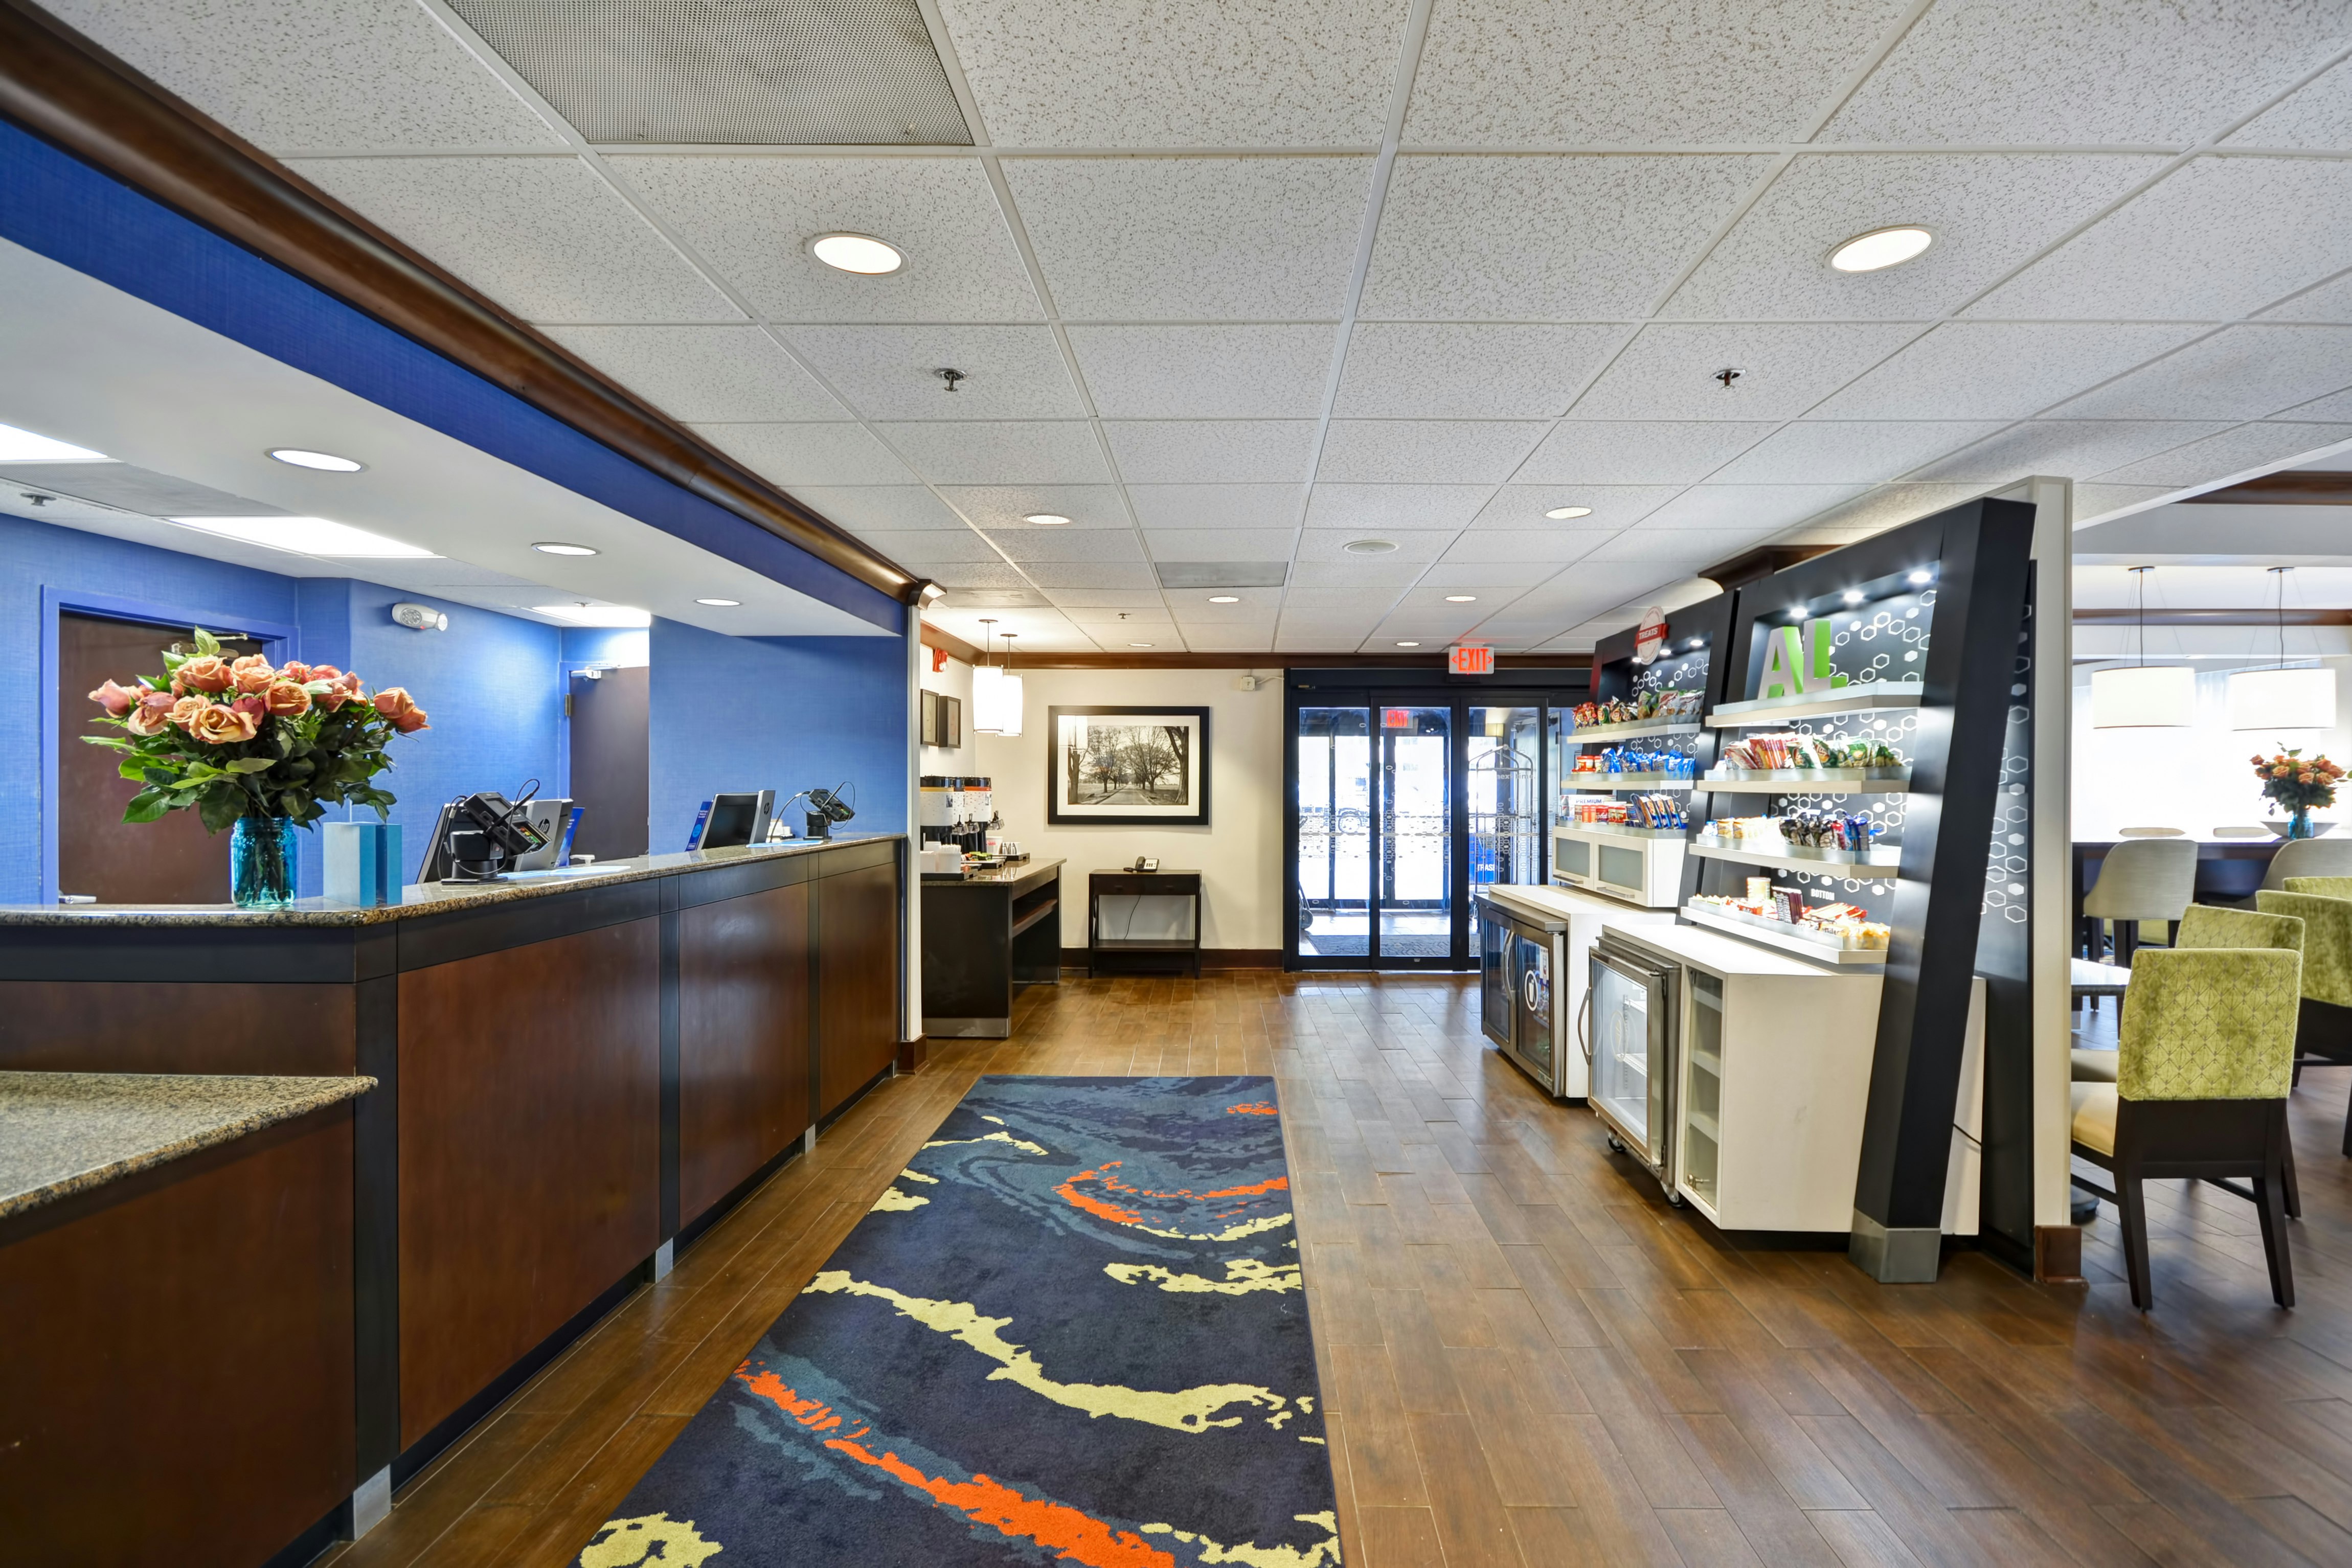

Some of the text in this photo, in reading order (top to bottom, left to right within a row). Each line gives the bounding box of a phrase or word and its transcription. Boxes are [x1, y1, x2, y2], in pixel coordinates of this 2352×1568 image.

[1458, 648, 1488, 671] EXIT
[1387, 710, 1409, 727] EXIT
[538, 818, 550, 834] hp
[1811, 888, 1835, 901] BOTTOM
